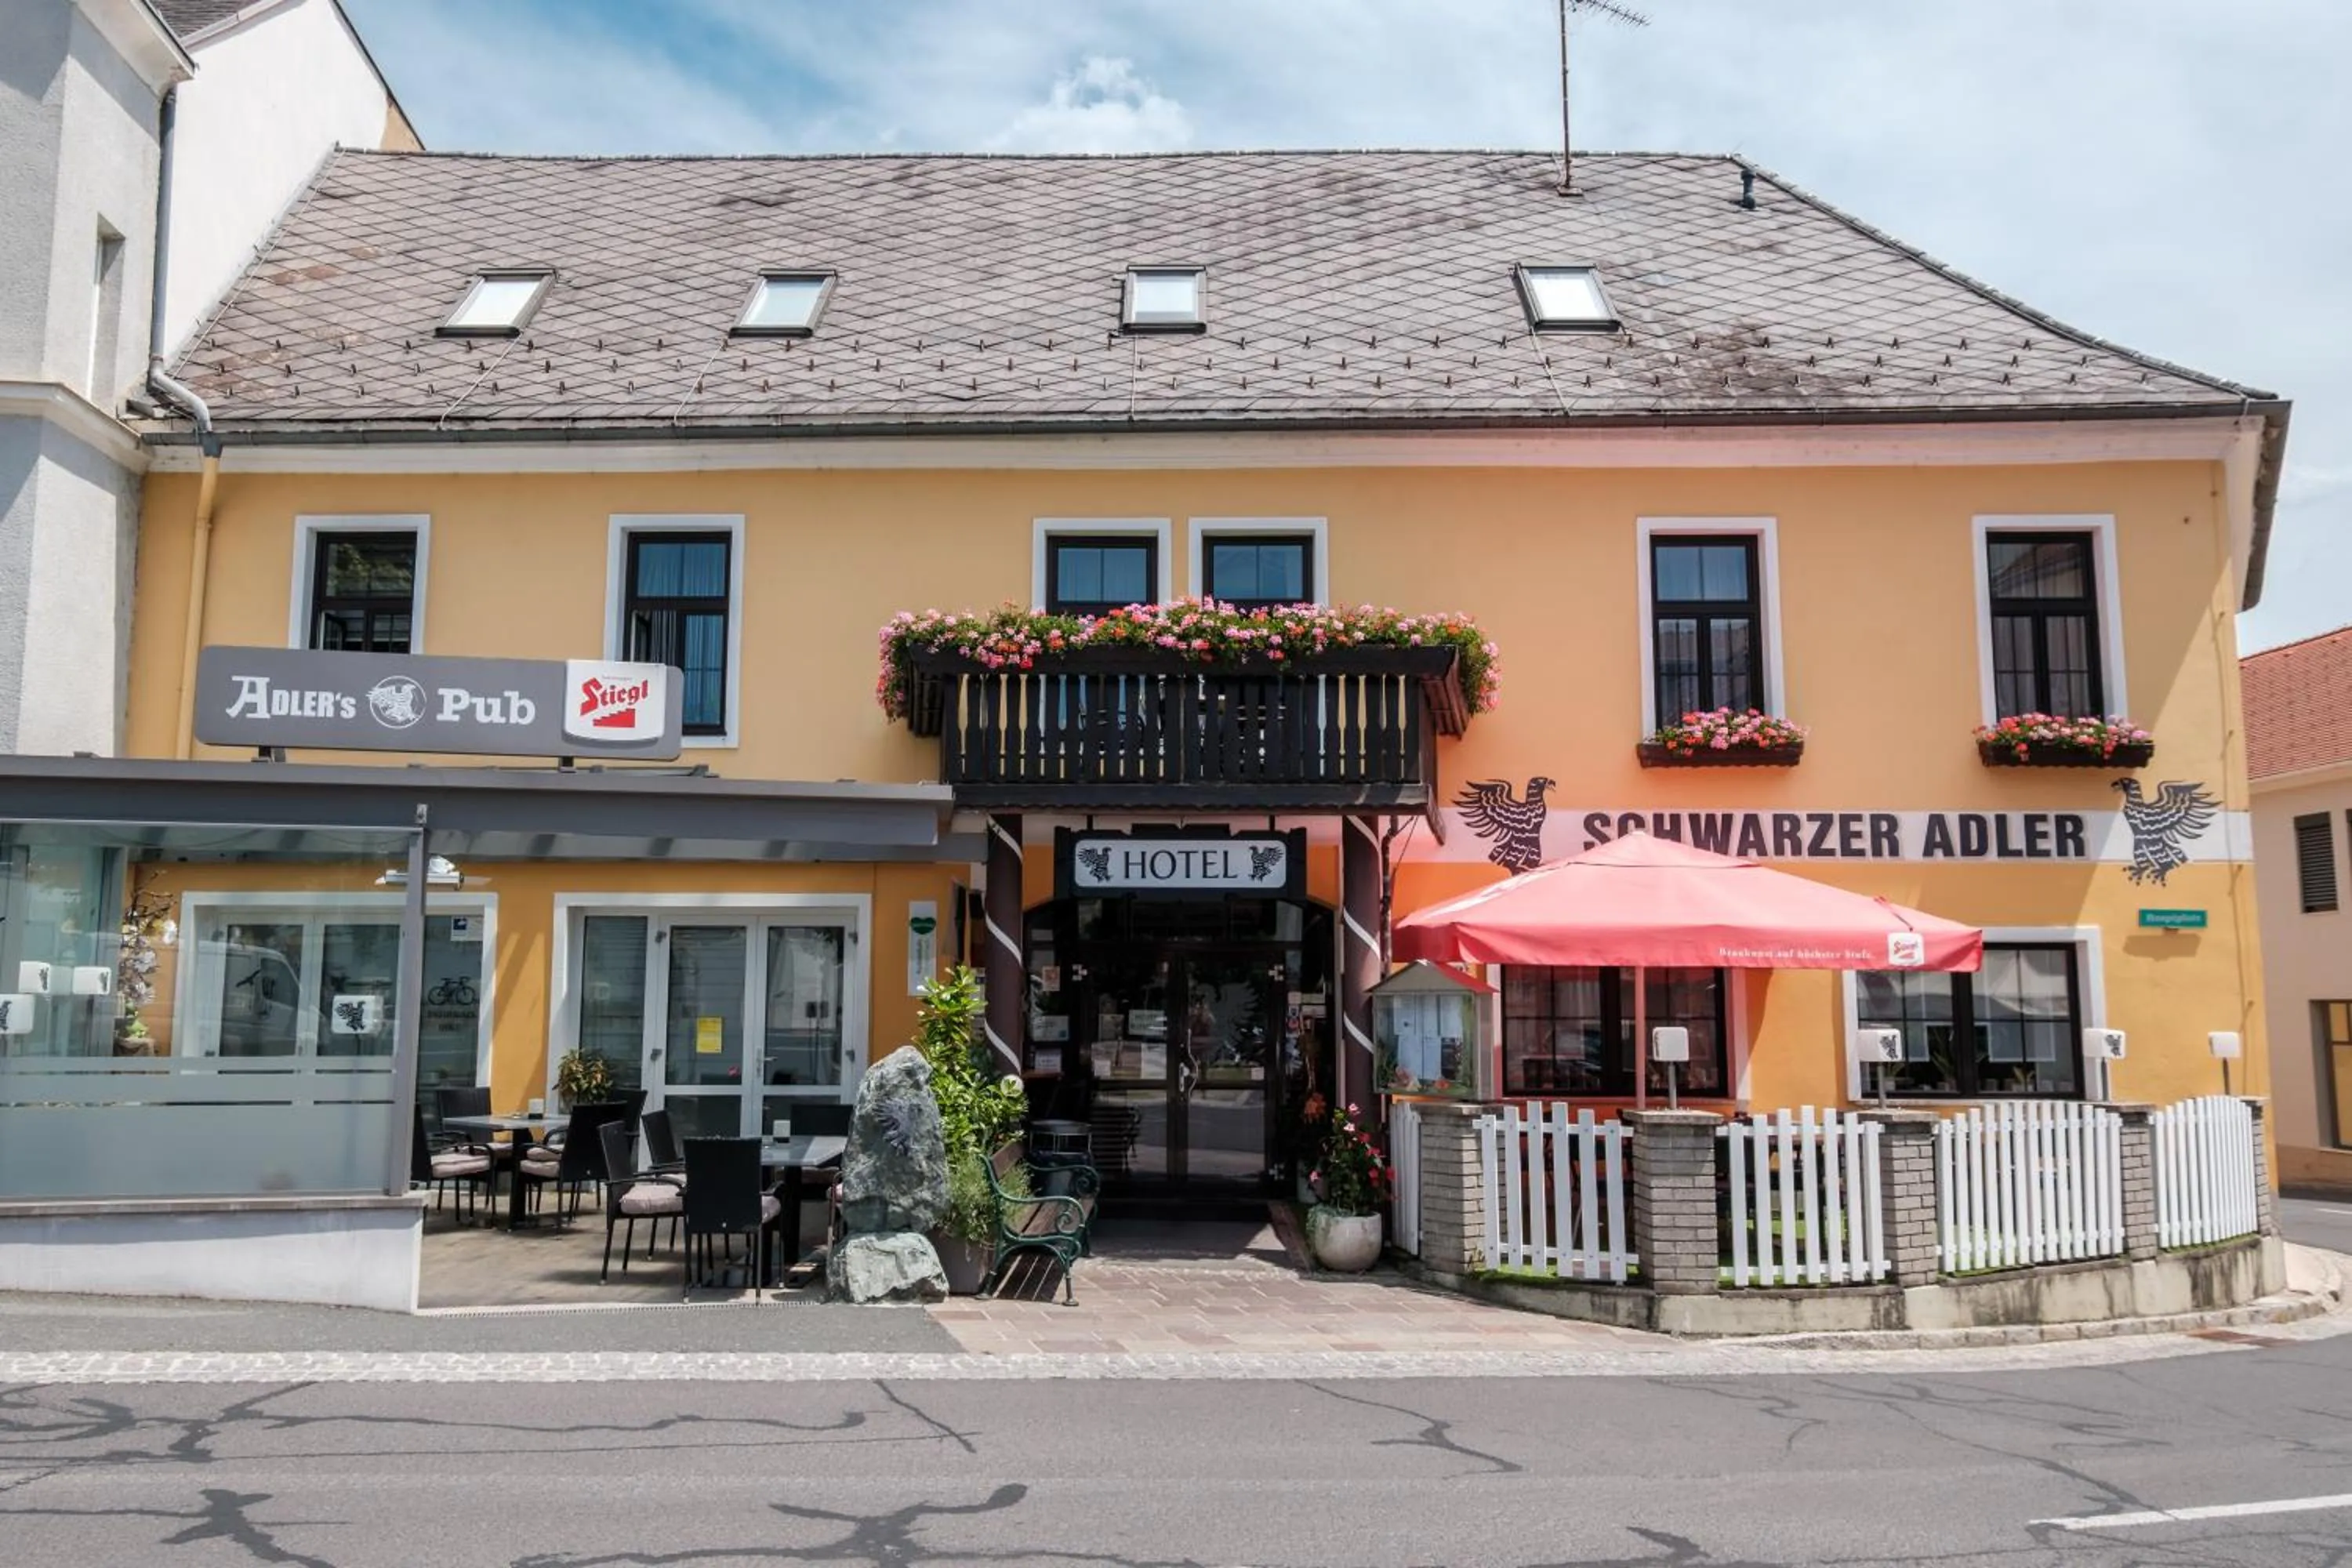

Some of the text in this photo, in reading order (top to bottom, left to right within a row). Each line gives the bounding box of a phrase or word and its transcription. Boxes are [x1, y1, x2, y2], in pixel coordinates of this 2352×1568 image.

[436, 688, 535, 725] Pub
[579, 677, 648, 716] Stiegl
[1922, 813, 2085, 857] ADLER
[1123, 849, 1239, 880] HOTEL
